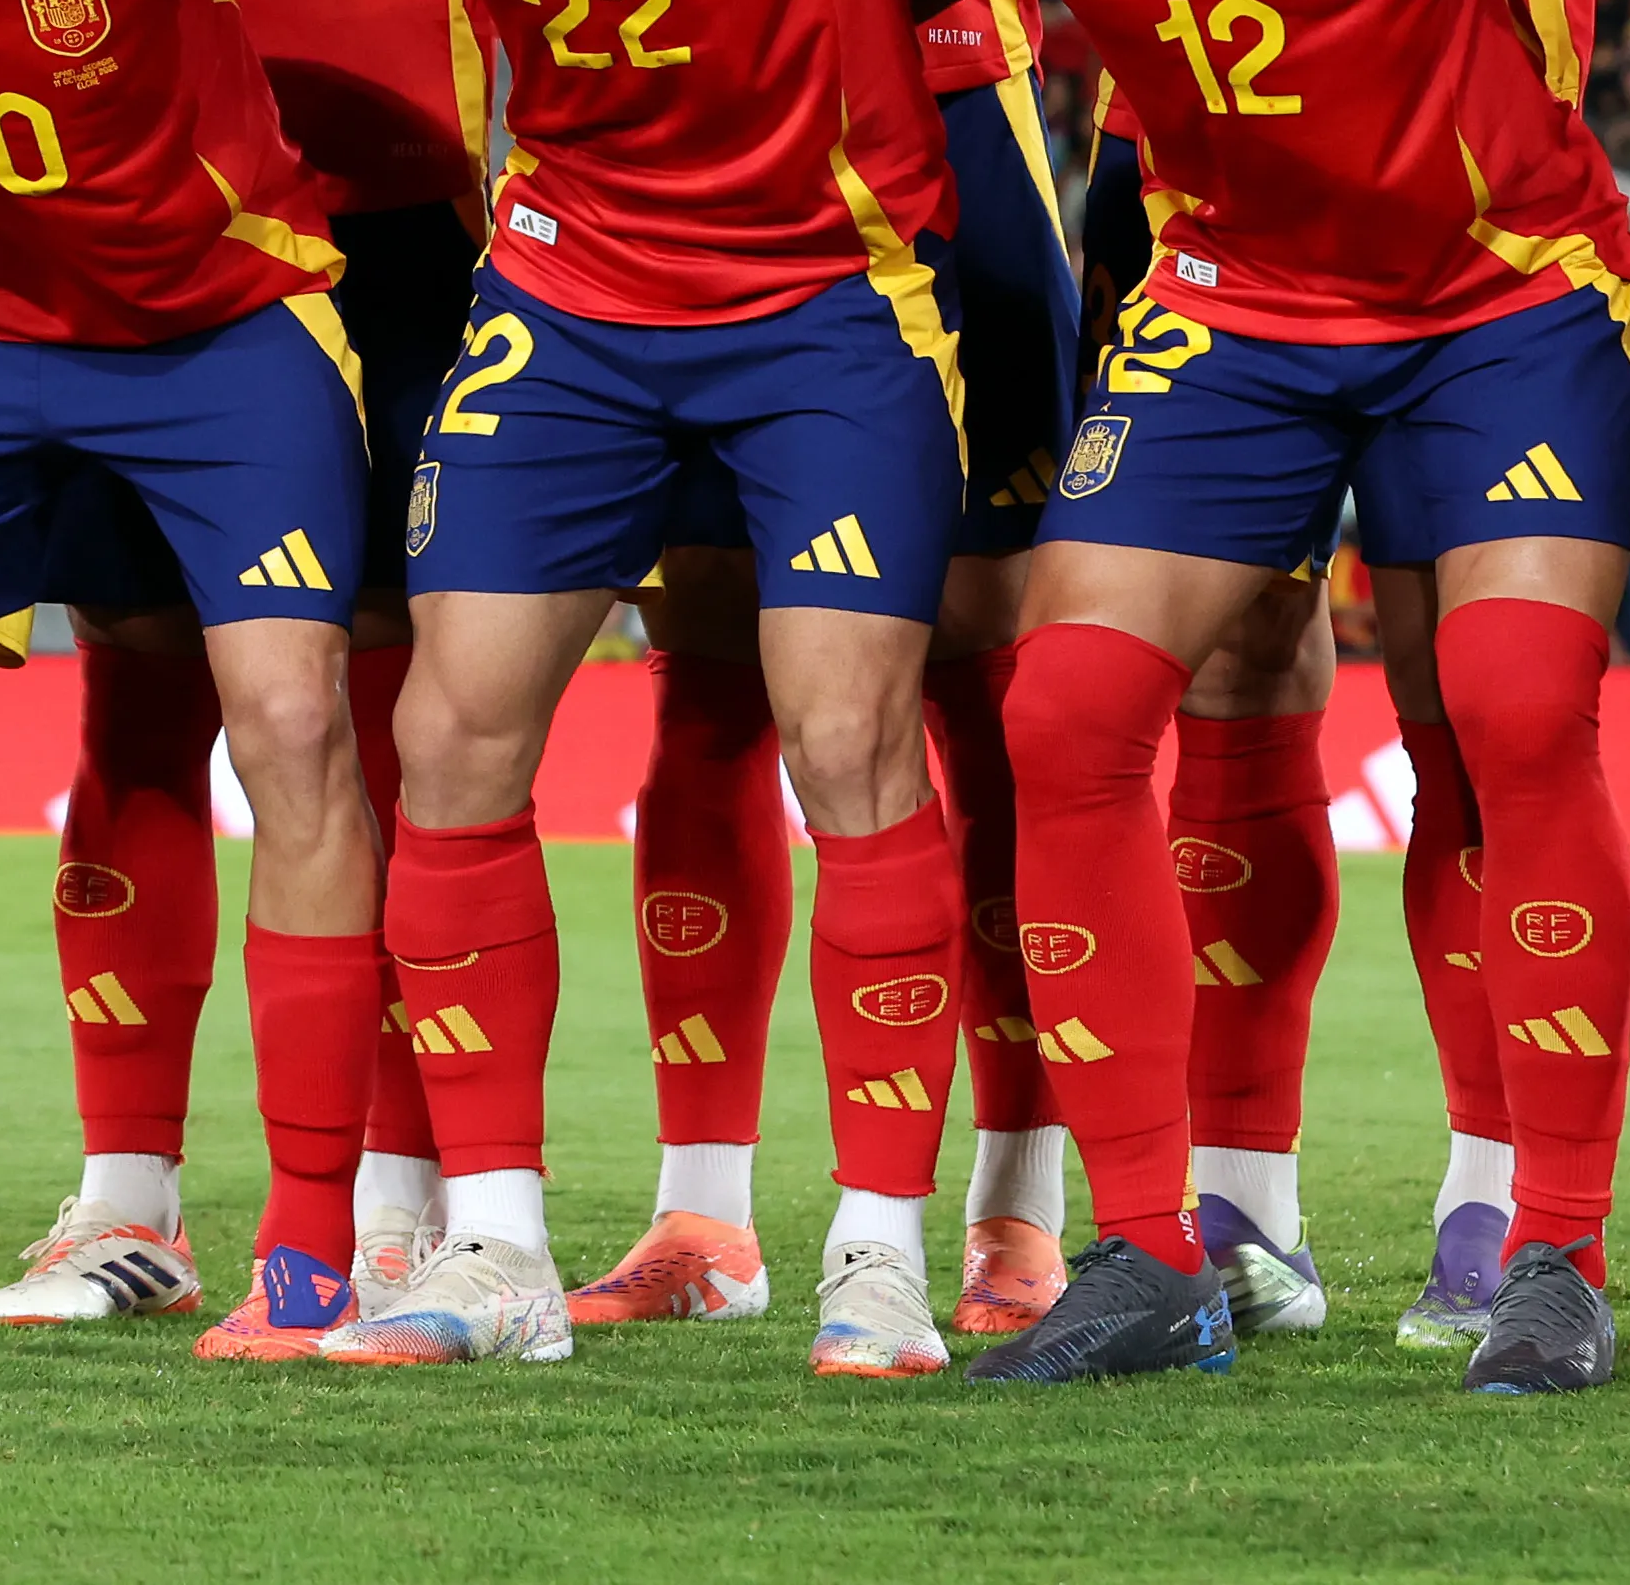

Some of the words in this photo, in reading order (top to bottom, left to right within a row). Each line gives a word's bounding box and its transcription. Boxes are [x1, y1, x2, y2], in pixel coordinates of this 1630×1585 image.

[927, 27, 982, 48] HEAT.RDY
[425, 311, 535, 436] 2
[656, 904, 704, 921] RF
[1526, 913, 1571, 928] RF
[657, 924, 703, 941] EF
[1527, 929, 1572, 944] EF
[1028, 933, 1069, 949] RF
[1029, 949, 1071, 963] EF
[879, 984, 931, 1003] RF
[880, 1000, 931, 1016] EF
